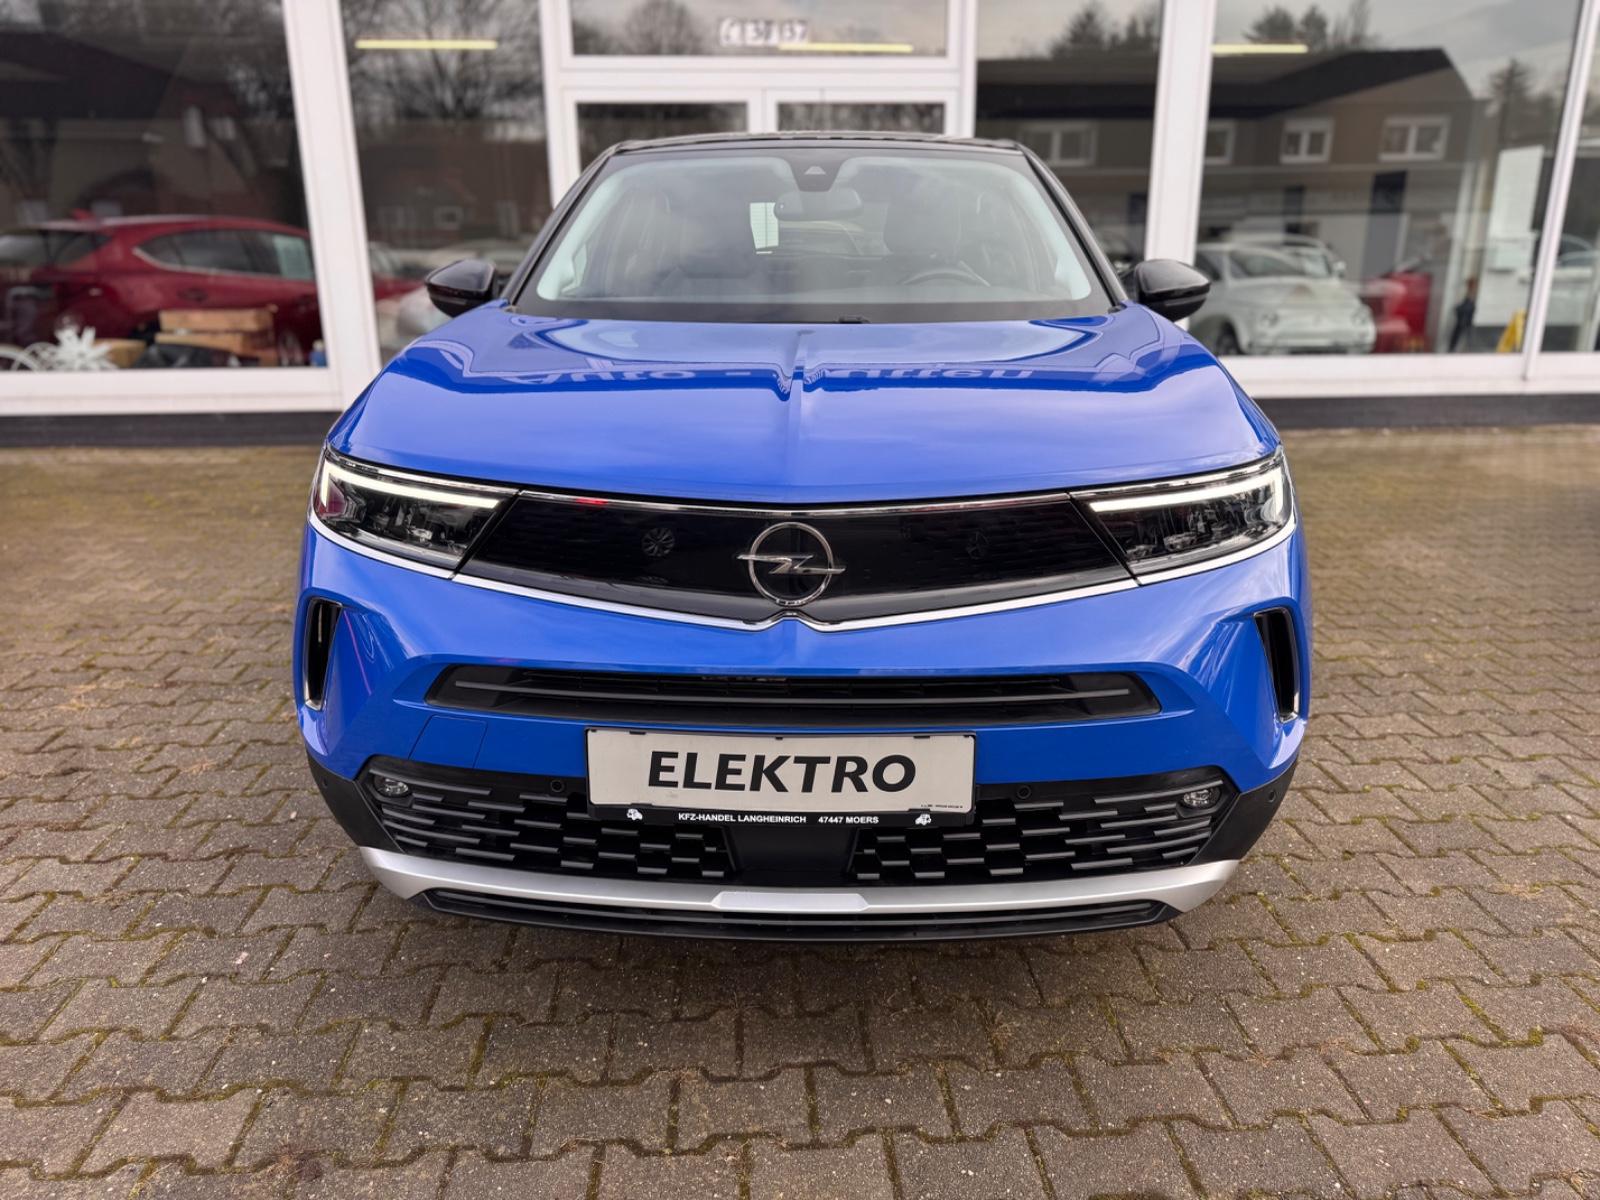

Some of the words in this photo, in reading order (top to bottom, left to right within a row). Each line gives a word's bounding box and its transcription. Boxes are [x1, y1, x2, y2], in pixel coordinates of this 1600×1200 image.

[648, 751, 916, 793] ELEKTRO
[678, 813, 736, 822] KFZ-HANDEL
[737, 814, 807, 823] LANGHEINRICH
[818, 816, 843, 824] 47447
[845, 816, 879, 824] MOERS
